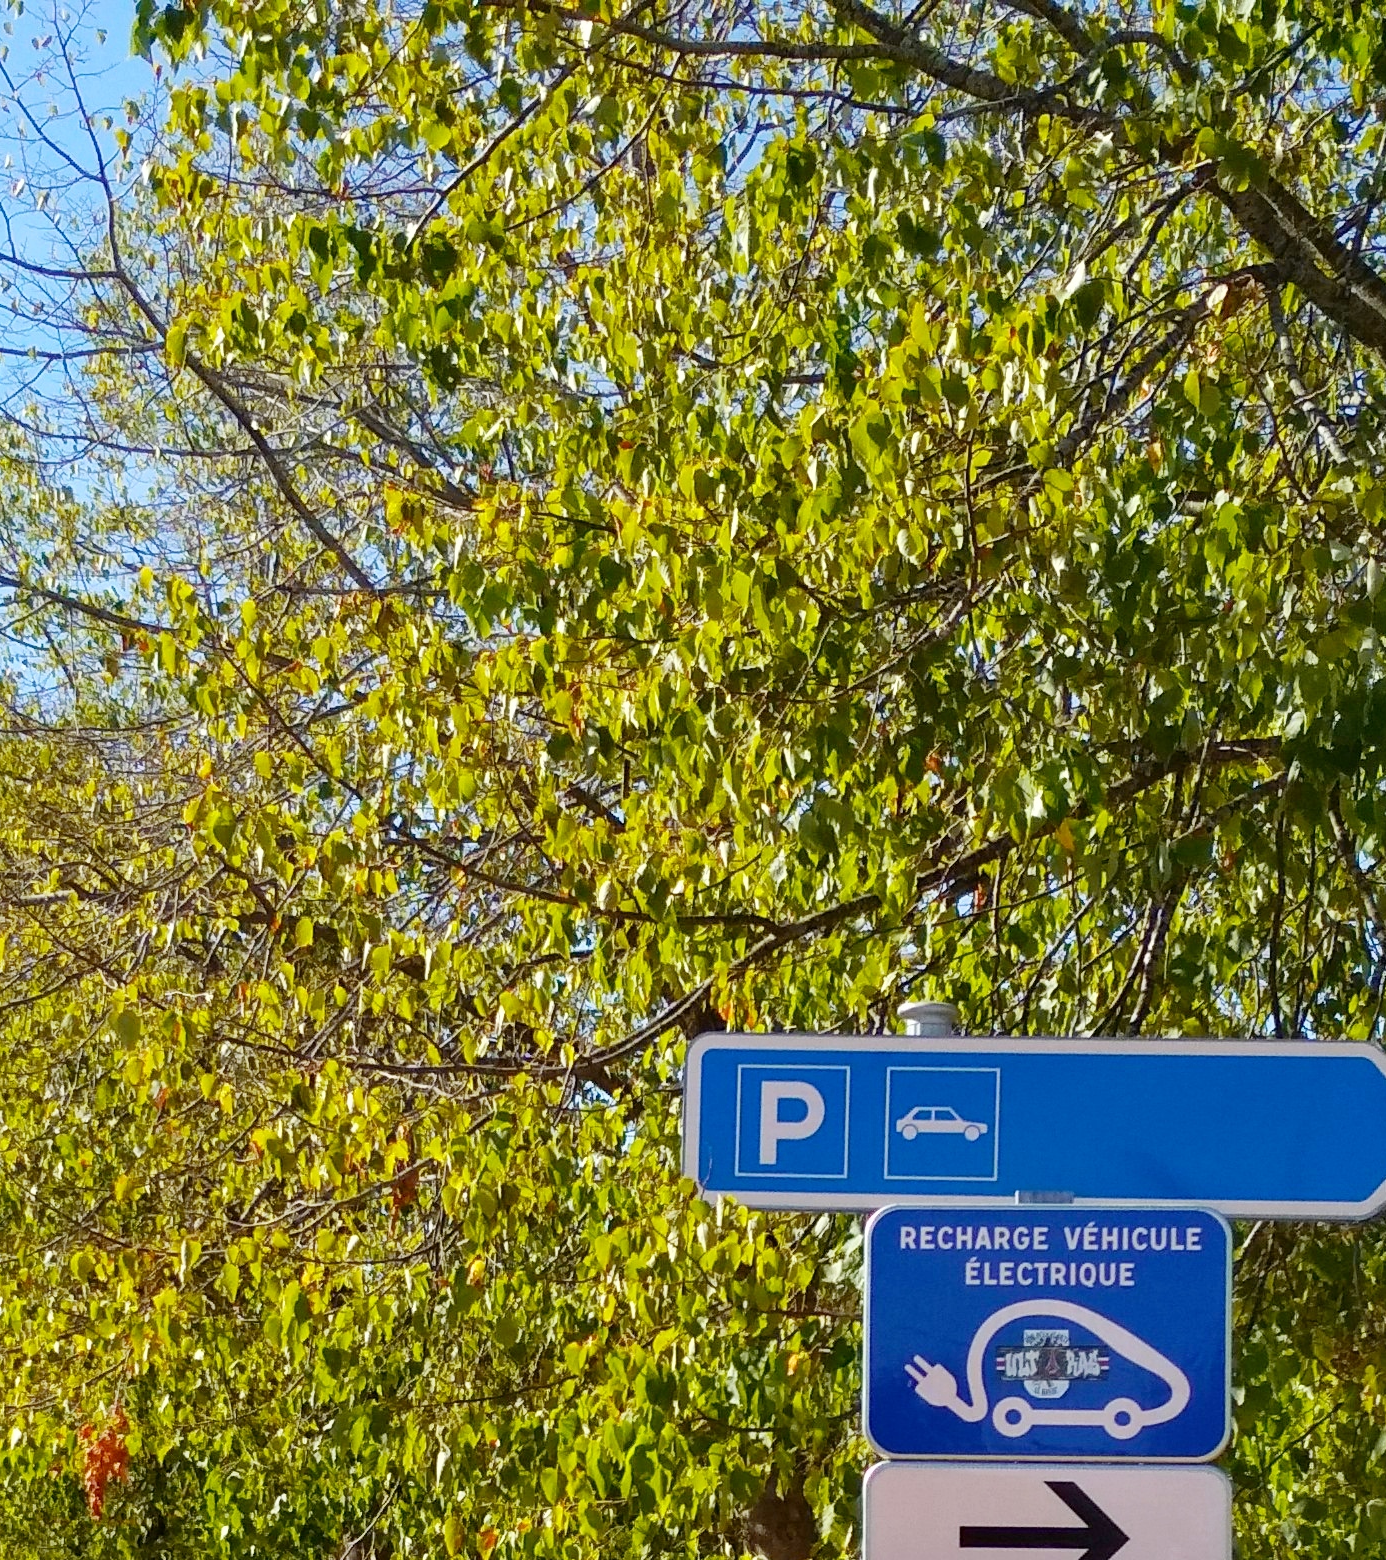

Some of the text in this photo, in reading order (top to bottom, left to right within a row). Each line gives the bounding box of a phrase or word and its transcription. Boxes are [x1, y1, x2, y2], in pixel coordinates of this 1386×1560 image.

[758, 1080, 826, 1165] P
[899, 1221, 1202, 1251] RECHARGE VÉHICULE
[965, 1256, 1135, 1288] ÉLECTRIQUE
